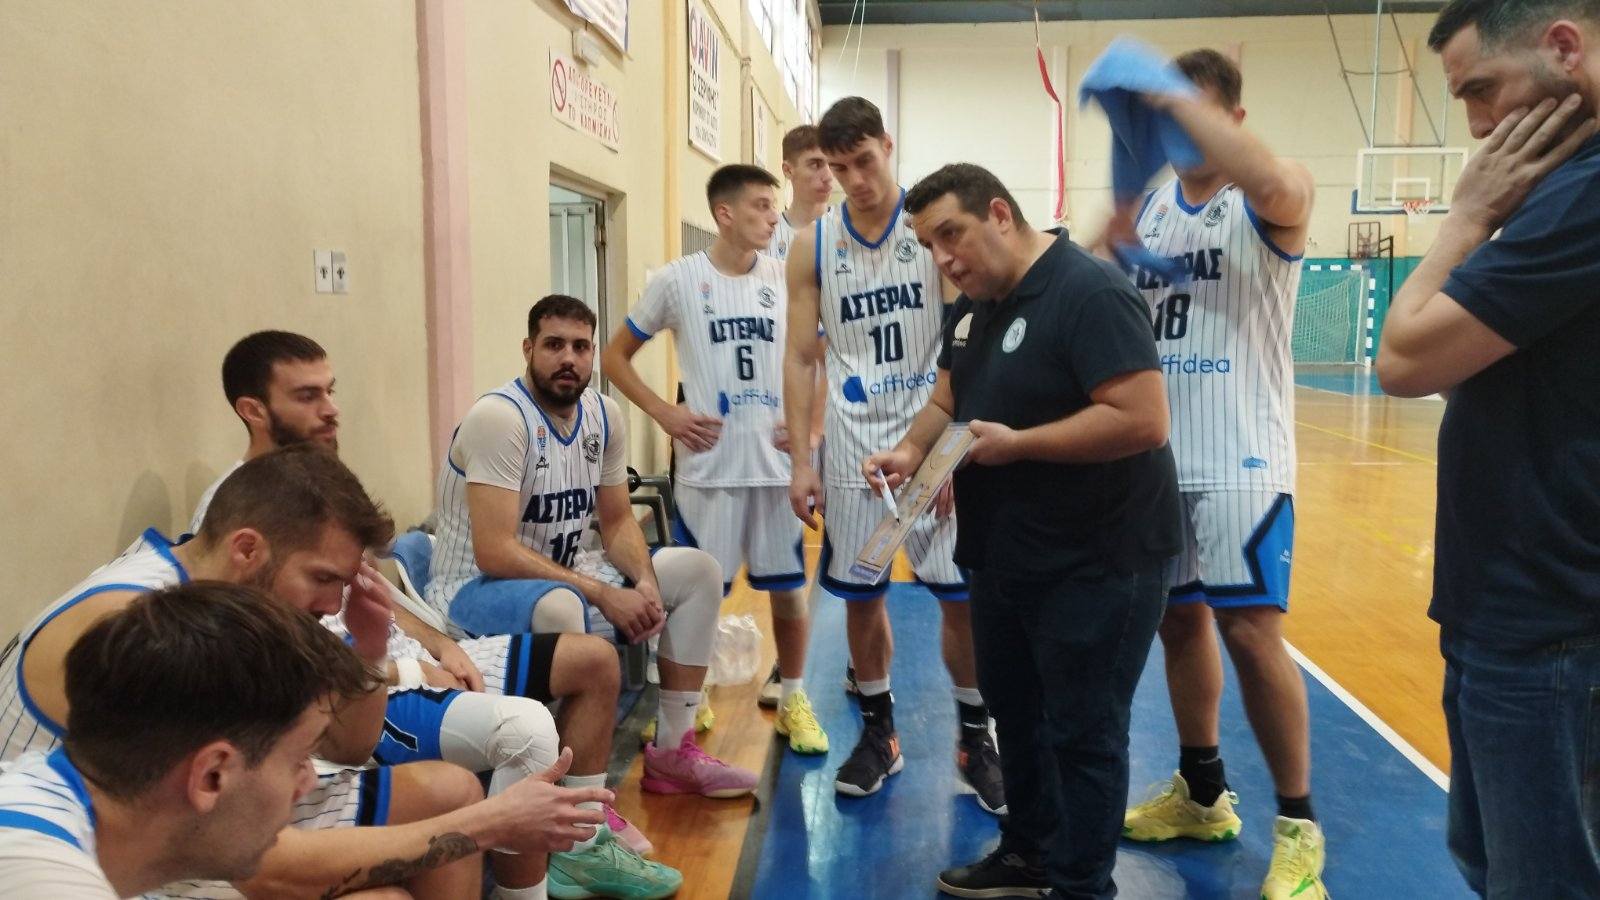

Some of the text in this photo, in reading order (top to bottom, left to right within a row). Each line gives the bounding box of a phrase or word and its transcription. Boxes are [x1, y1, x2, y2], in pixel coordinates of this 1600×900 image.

[840, 282, 924, 323] ΑΣΤΕΡΑΣ
[1153, 293, 1191, 341] 18
[737, 345, 754, 381] 6
[868, 321, 904, 365] 10
[869, 370, 937, 396] affidea
[1160, 353, 1230, 375] ffidea
[550, 529, 583, 569] 16
